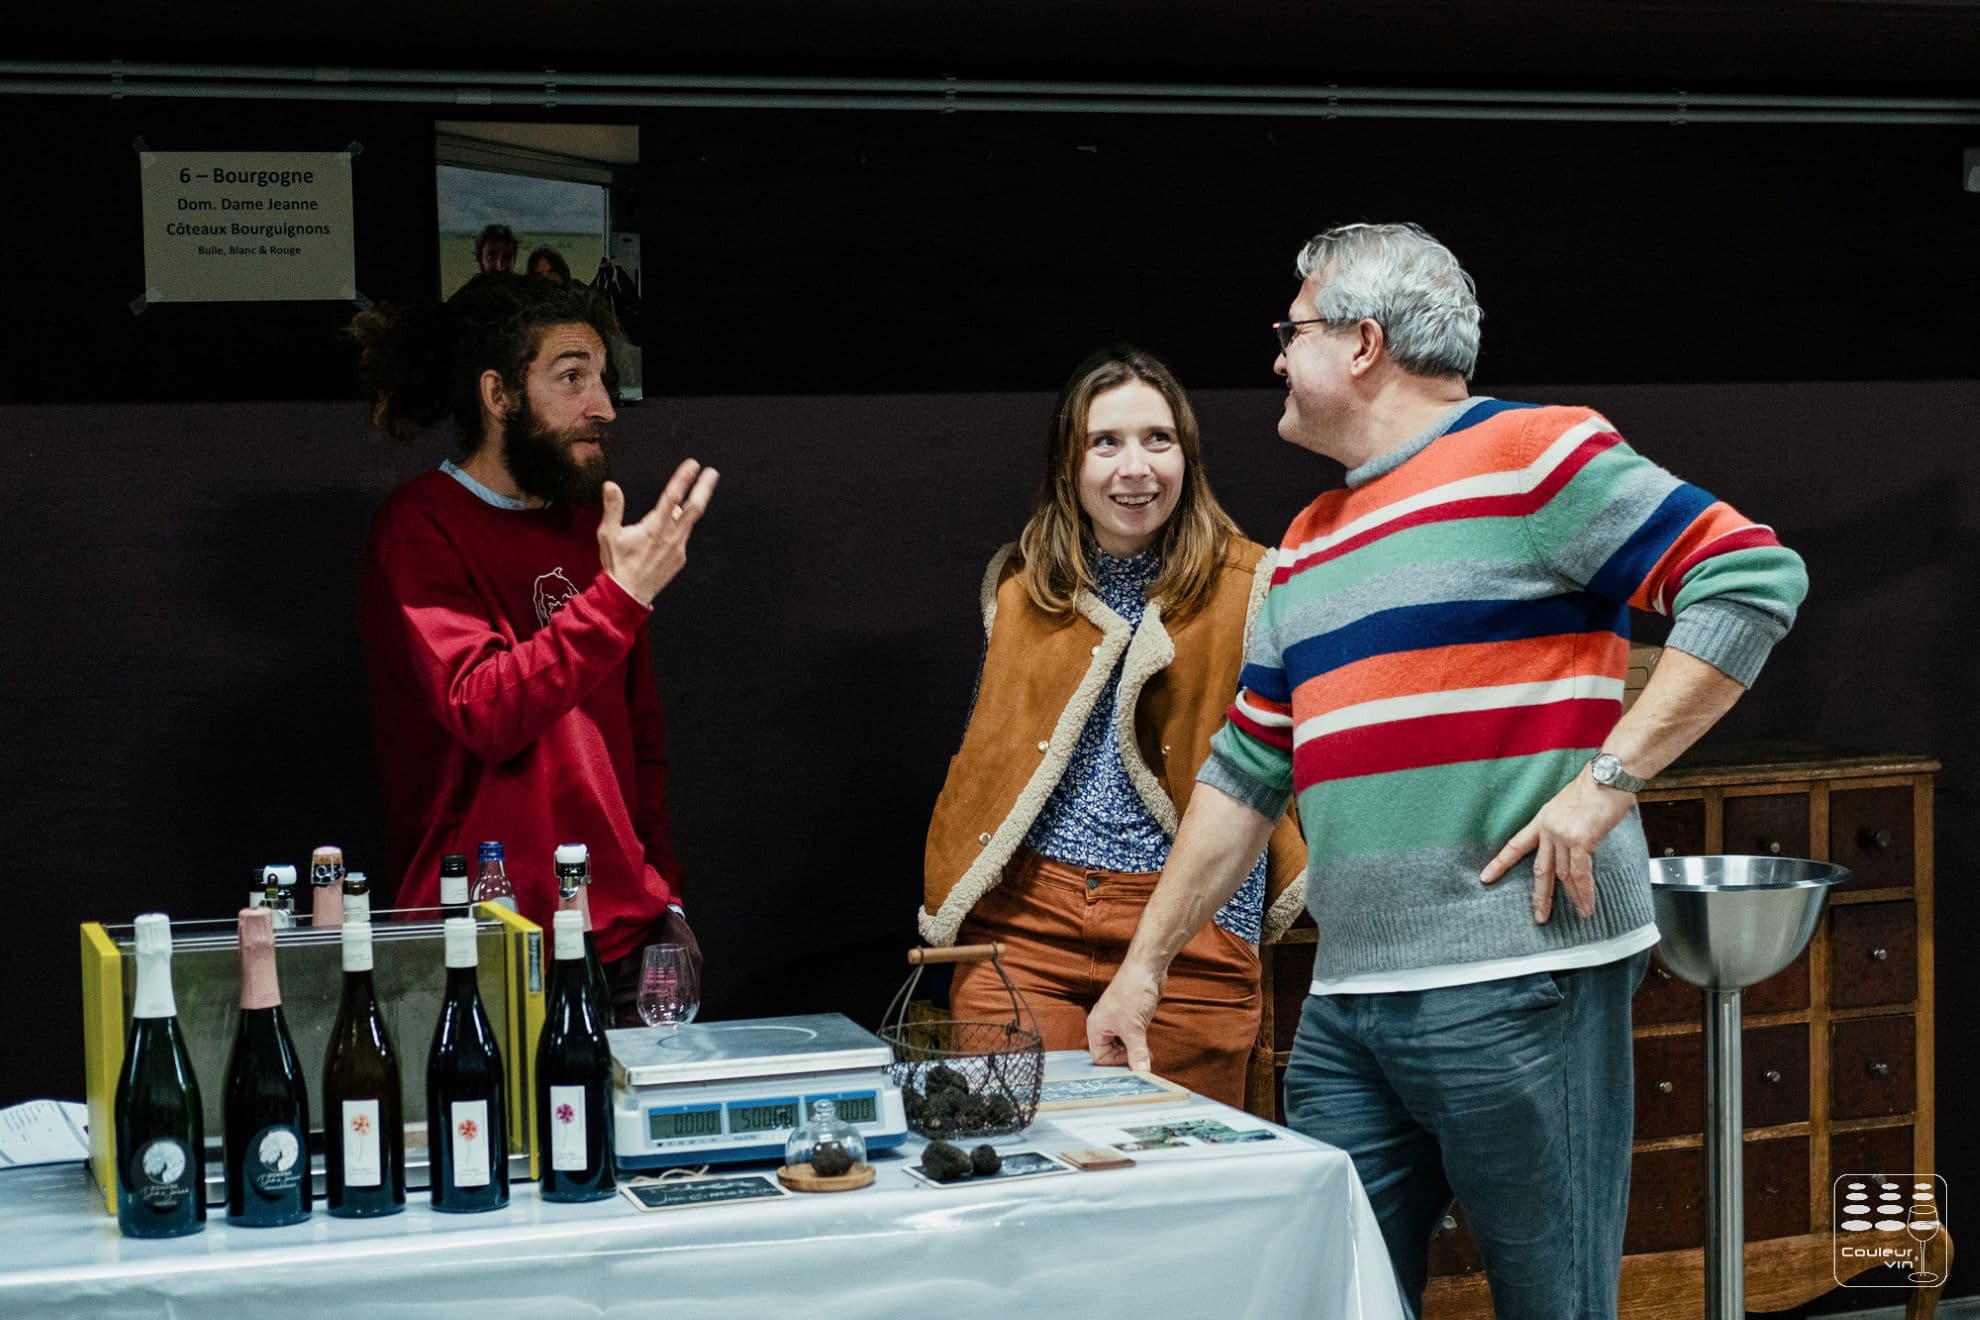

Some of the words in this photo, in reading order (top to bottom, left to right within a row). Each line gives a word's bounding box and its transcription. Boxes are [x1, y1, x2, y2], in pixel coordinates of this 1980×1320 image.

[180, 168, 190, 183] 6
[213, 168, 314, 187] Bourgogne
[177, 198, 216, 211] Dom.
[221, 198, 263, 211] Dame
[267, 198, 318, 211] Jeanne
[166, 221, 227, 236] Côteaux
[231, 222, 330, 238] Bourguignons
[229, 246, 256, 256] Blanc
[258, 246, 267, 256] &
[270, 246, 301, 256] Rouge
